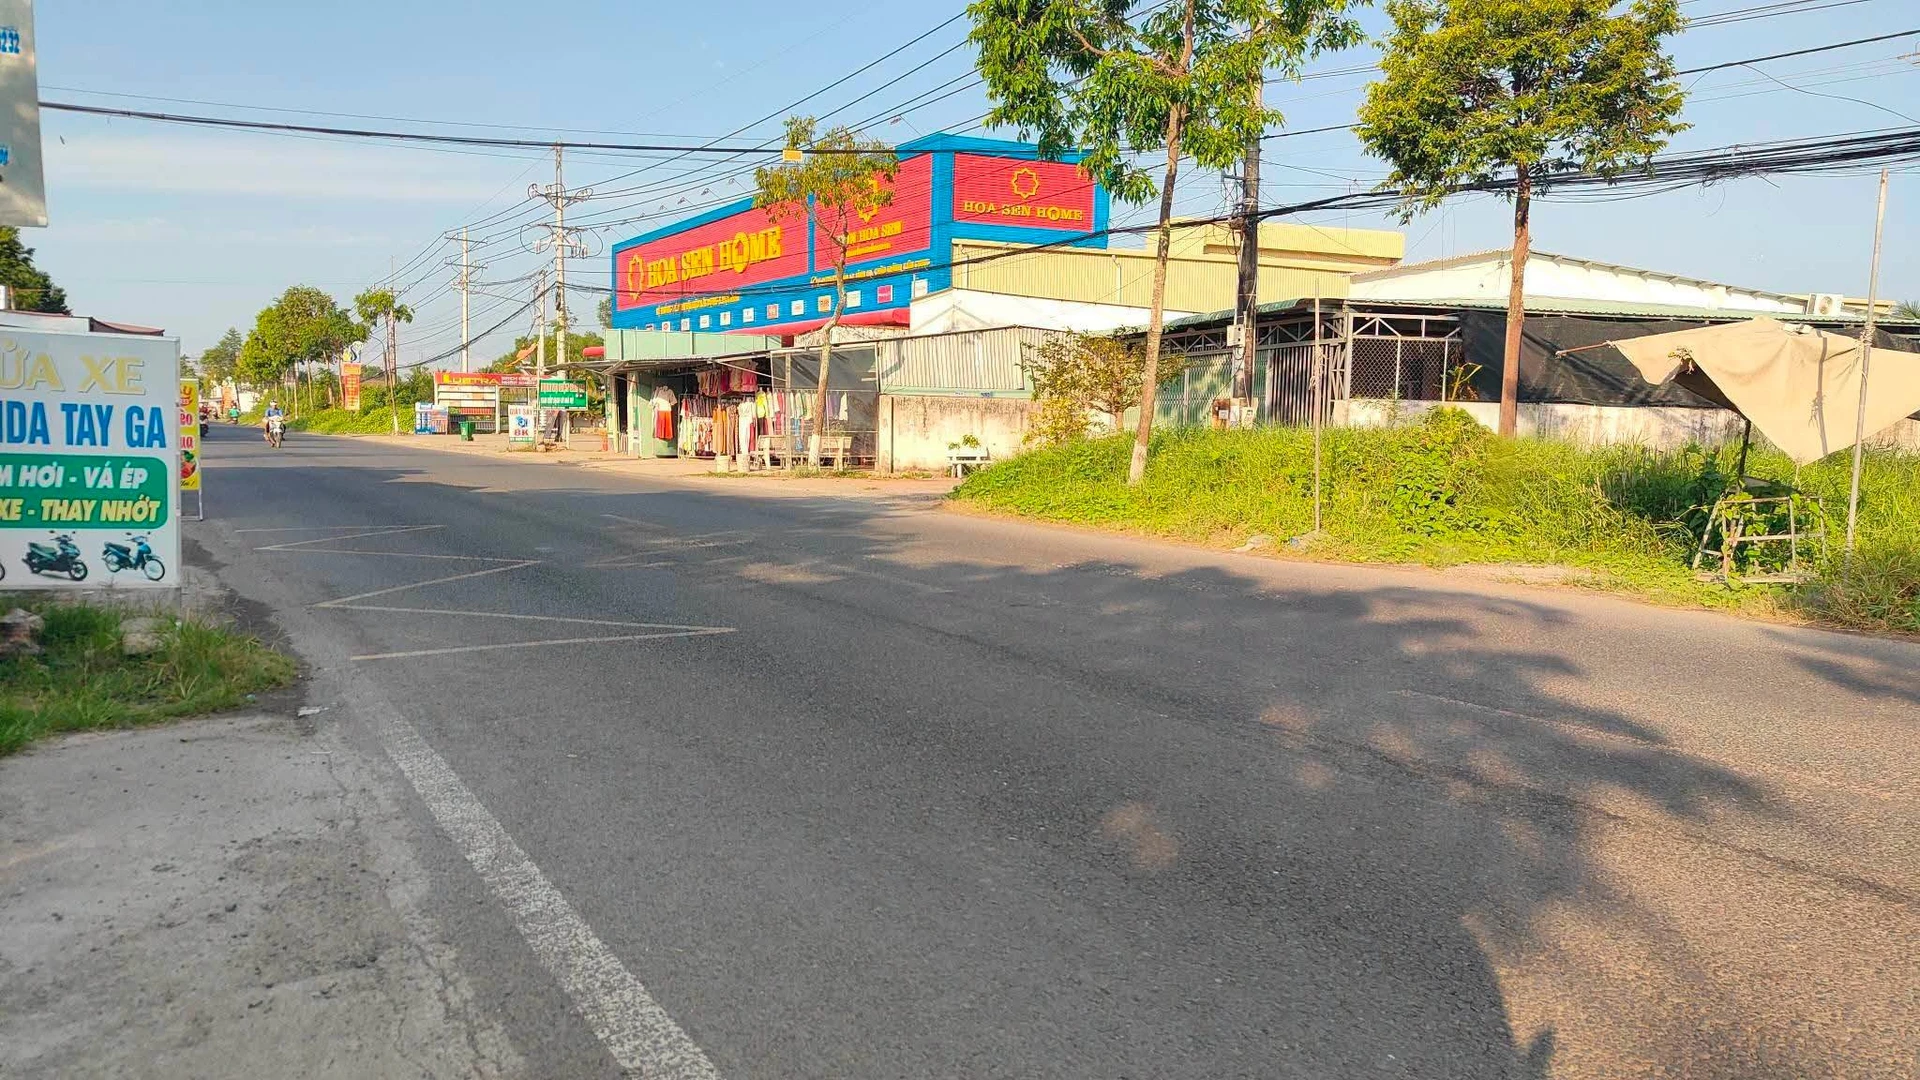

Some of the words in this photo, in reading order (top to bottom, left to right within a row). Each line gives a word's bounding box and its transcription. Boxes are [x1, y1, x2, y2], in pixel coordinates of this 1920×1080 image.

[0, 29, 20, 54] 232
[963, 201, 997, 214] HOA
[1001, 204, 1031, 217] SEN
[1036, 206, 1083, 221] HOME
[647, 256, 679, 289] HOA
[681, 246, 714, 281] SEN
[718, 226, 781, 274] HOME
[78, 355, 146, 395] XE
[0, 400, 50, 445] DA
[61, 403, 114, 447] TAY
[125, 405, 167, 449] GA
[18, 461, 65, 489] HƠI
[83, 461, 115, 489] VÁ
[119, 461, 149, 490] ÉP
[41, 498, 98, 522] THAY
[100, 494, 161, 523] NHỚT
